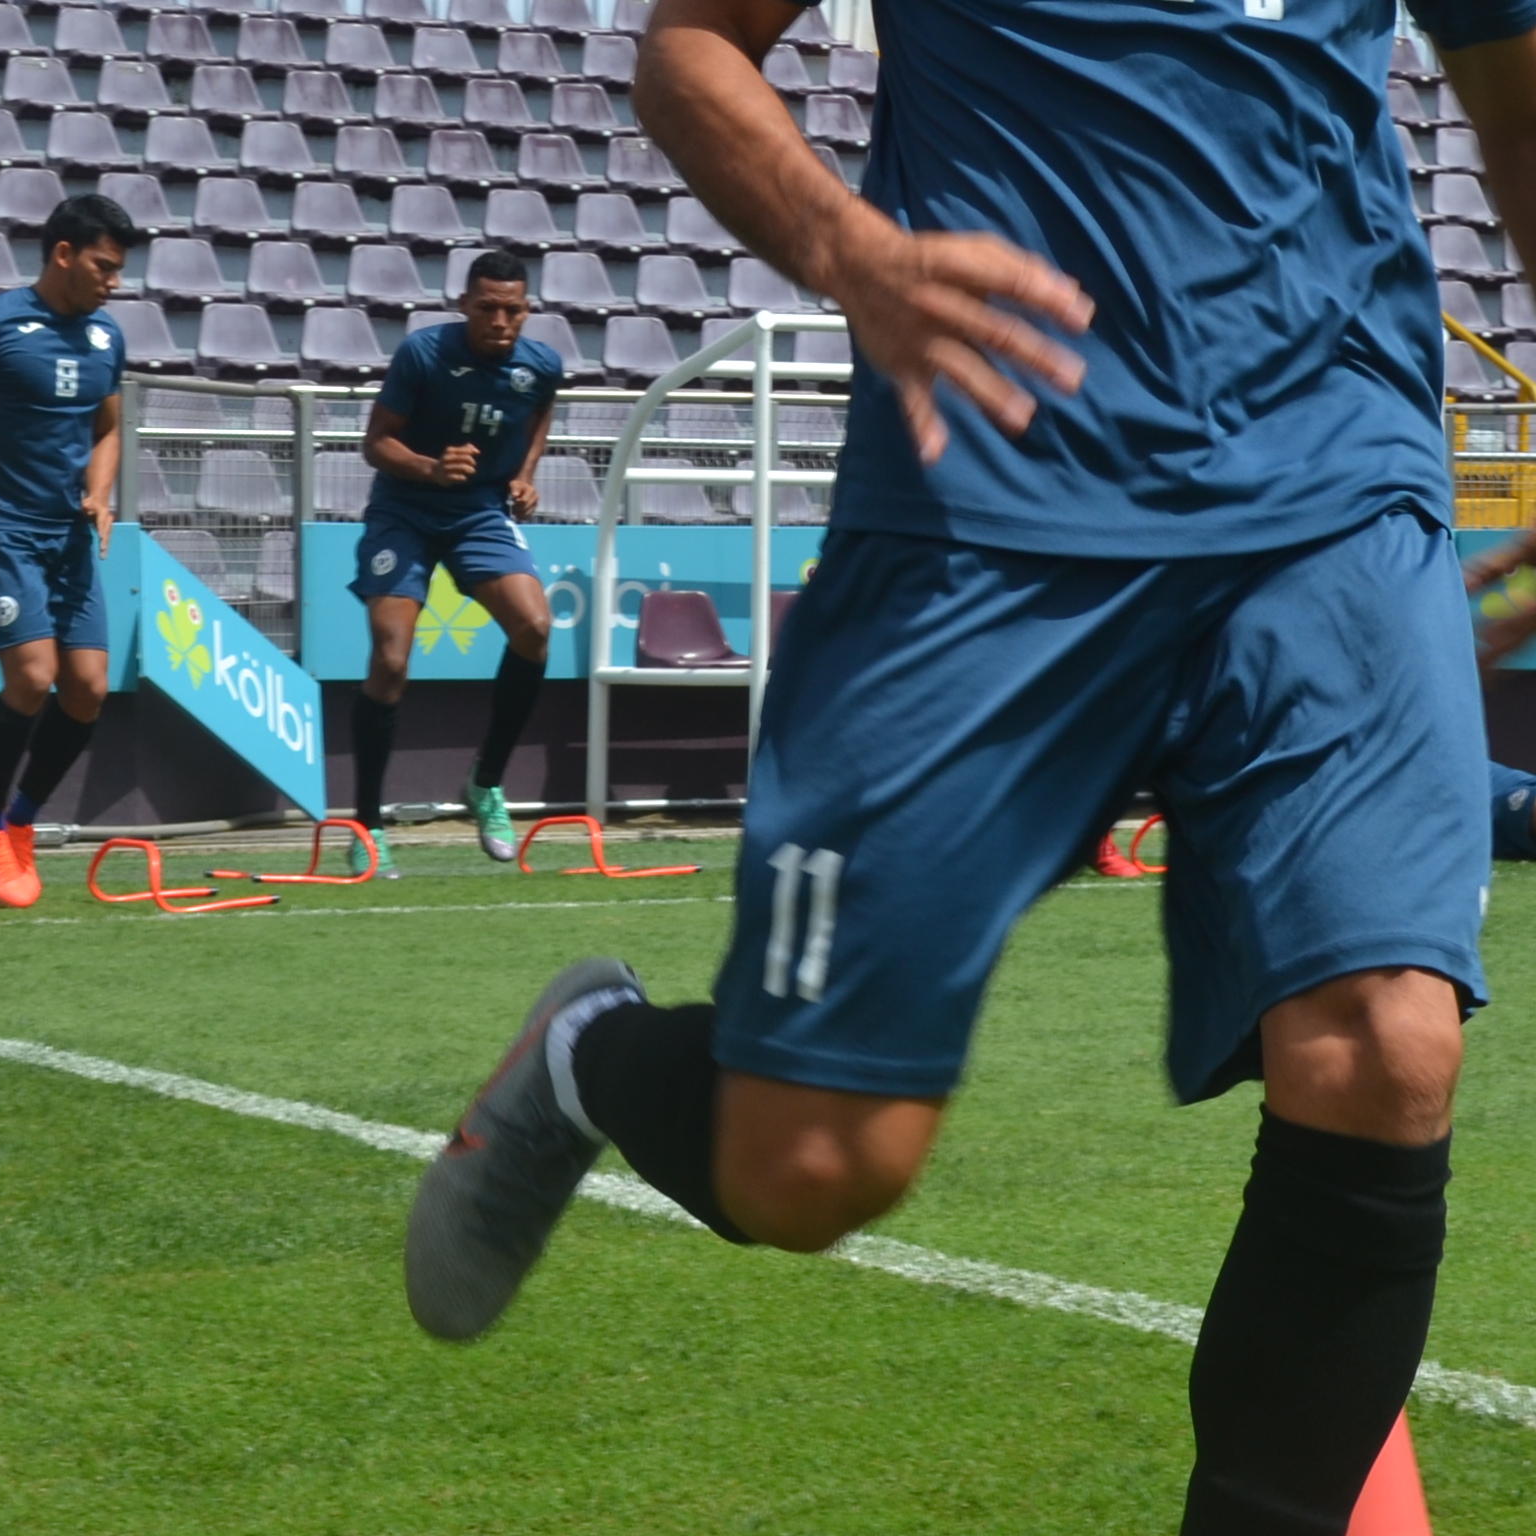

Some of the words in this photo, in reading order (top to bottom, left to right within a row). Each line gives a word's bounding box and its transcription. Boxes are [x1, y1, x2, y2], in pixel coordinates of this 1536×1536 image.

[55, 358, 80, 398] 8
[462, 402, 504, 437] 14
[213, 620, 314, 765] kölbi
[763, 843, 844, 1003] 11
